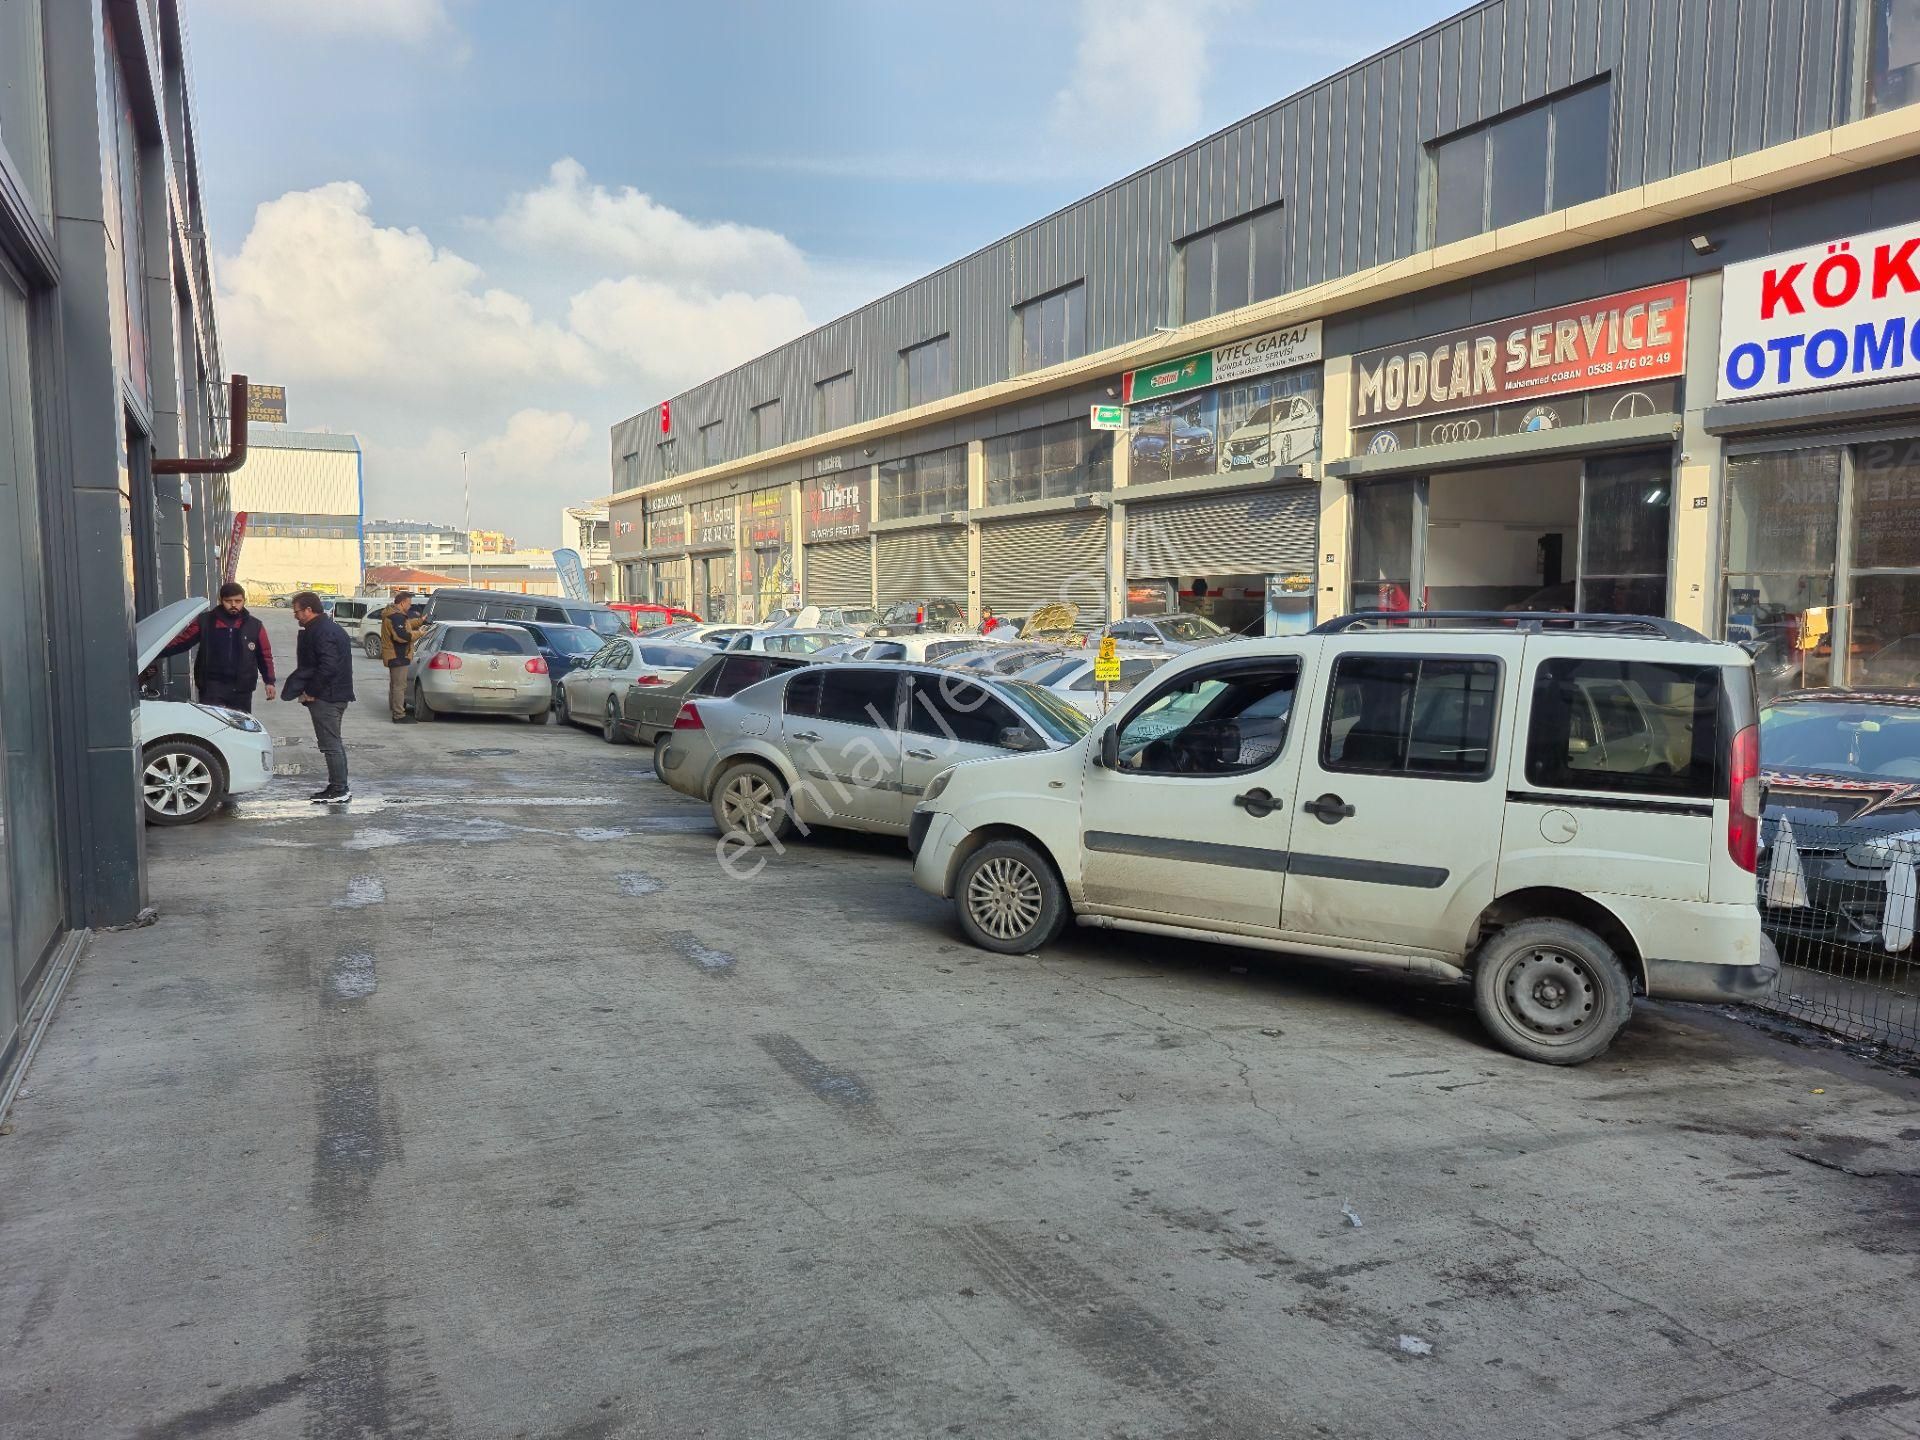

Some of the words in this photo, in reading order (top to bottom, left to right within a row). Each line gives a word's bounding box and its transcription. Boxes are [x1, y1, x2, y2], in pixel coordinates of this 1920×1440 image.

[1761, 238, 1920, 320] KÖK
[1216, 342, 1252, 364] VTEC
[1255, 327, 1308, 354] GARAJ
[1357, 335, 1498, 417] MODCAR
[1505, 298, 1675, 374] SERVICE
[1726, 317, 1920, 390] OTOM
[1215, 361, 1243, 374] HONDA
[1505, 375, 1550, 391] Muhammed
[1551, 368, 1582, 384] ÇOBAN
[1587, 362, 1613, 376] 0538
[1616, 358, 1636, 371] 476
[1639, 355, 1654, 368] 02
[1656, 352, 1672, 364] 49
[247, 413, 283, 422] STORAN
[1693, 497, 1707, 508] 35
[835, 524, 860, 538] FASTER
